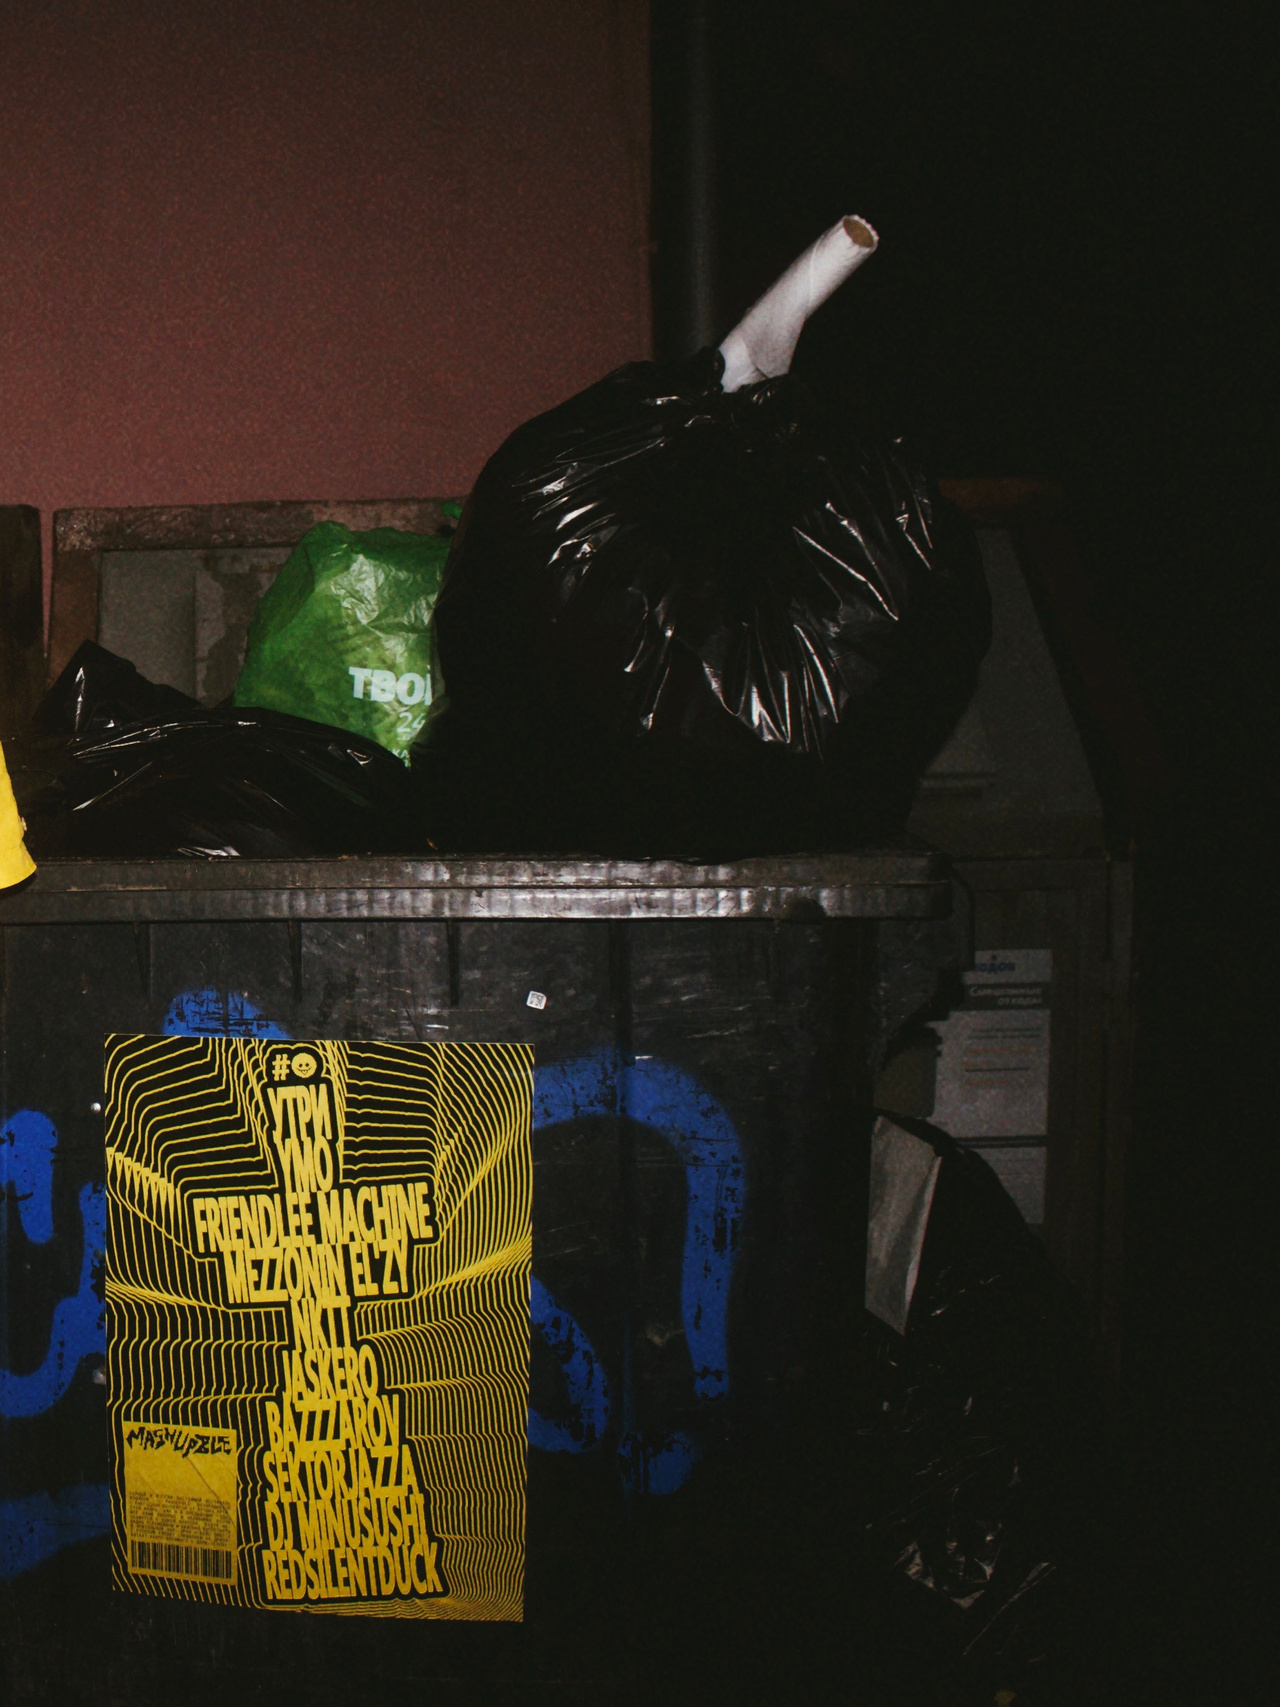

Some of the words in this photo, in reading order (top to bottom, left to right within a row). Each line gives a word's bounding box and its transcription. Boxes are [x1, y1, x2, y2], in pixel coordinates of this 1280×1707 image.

[193, 1191, 317, 1253] FRIENDLEE
[317, 1182, 434, 1246] MACHINE
[223, 1242, 348, 1304] MEZZONIN
[282, 1344, 379, 1403] JASKERO
[263, 1444, 420, 1503] SEKTORJAZZA
[264, 1500, 294, 1551] DJ
[296, 1493, 429, 1551] MINUSUSHI
[262, 1542, 443, 1600] REDSILENTDUCK
